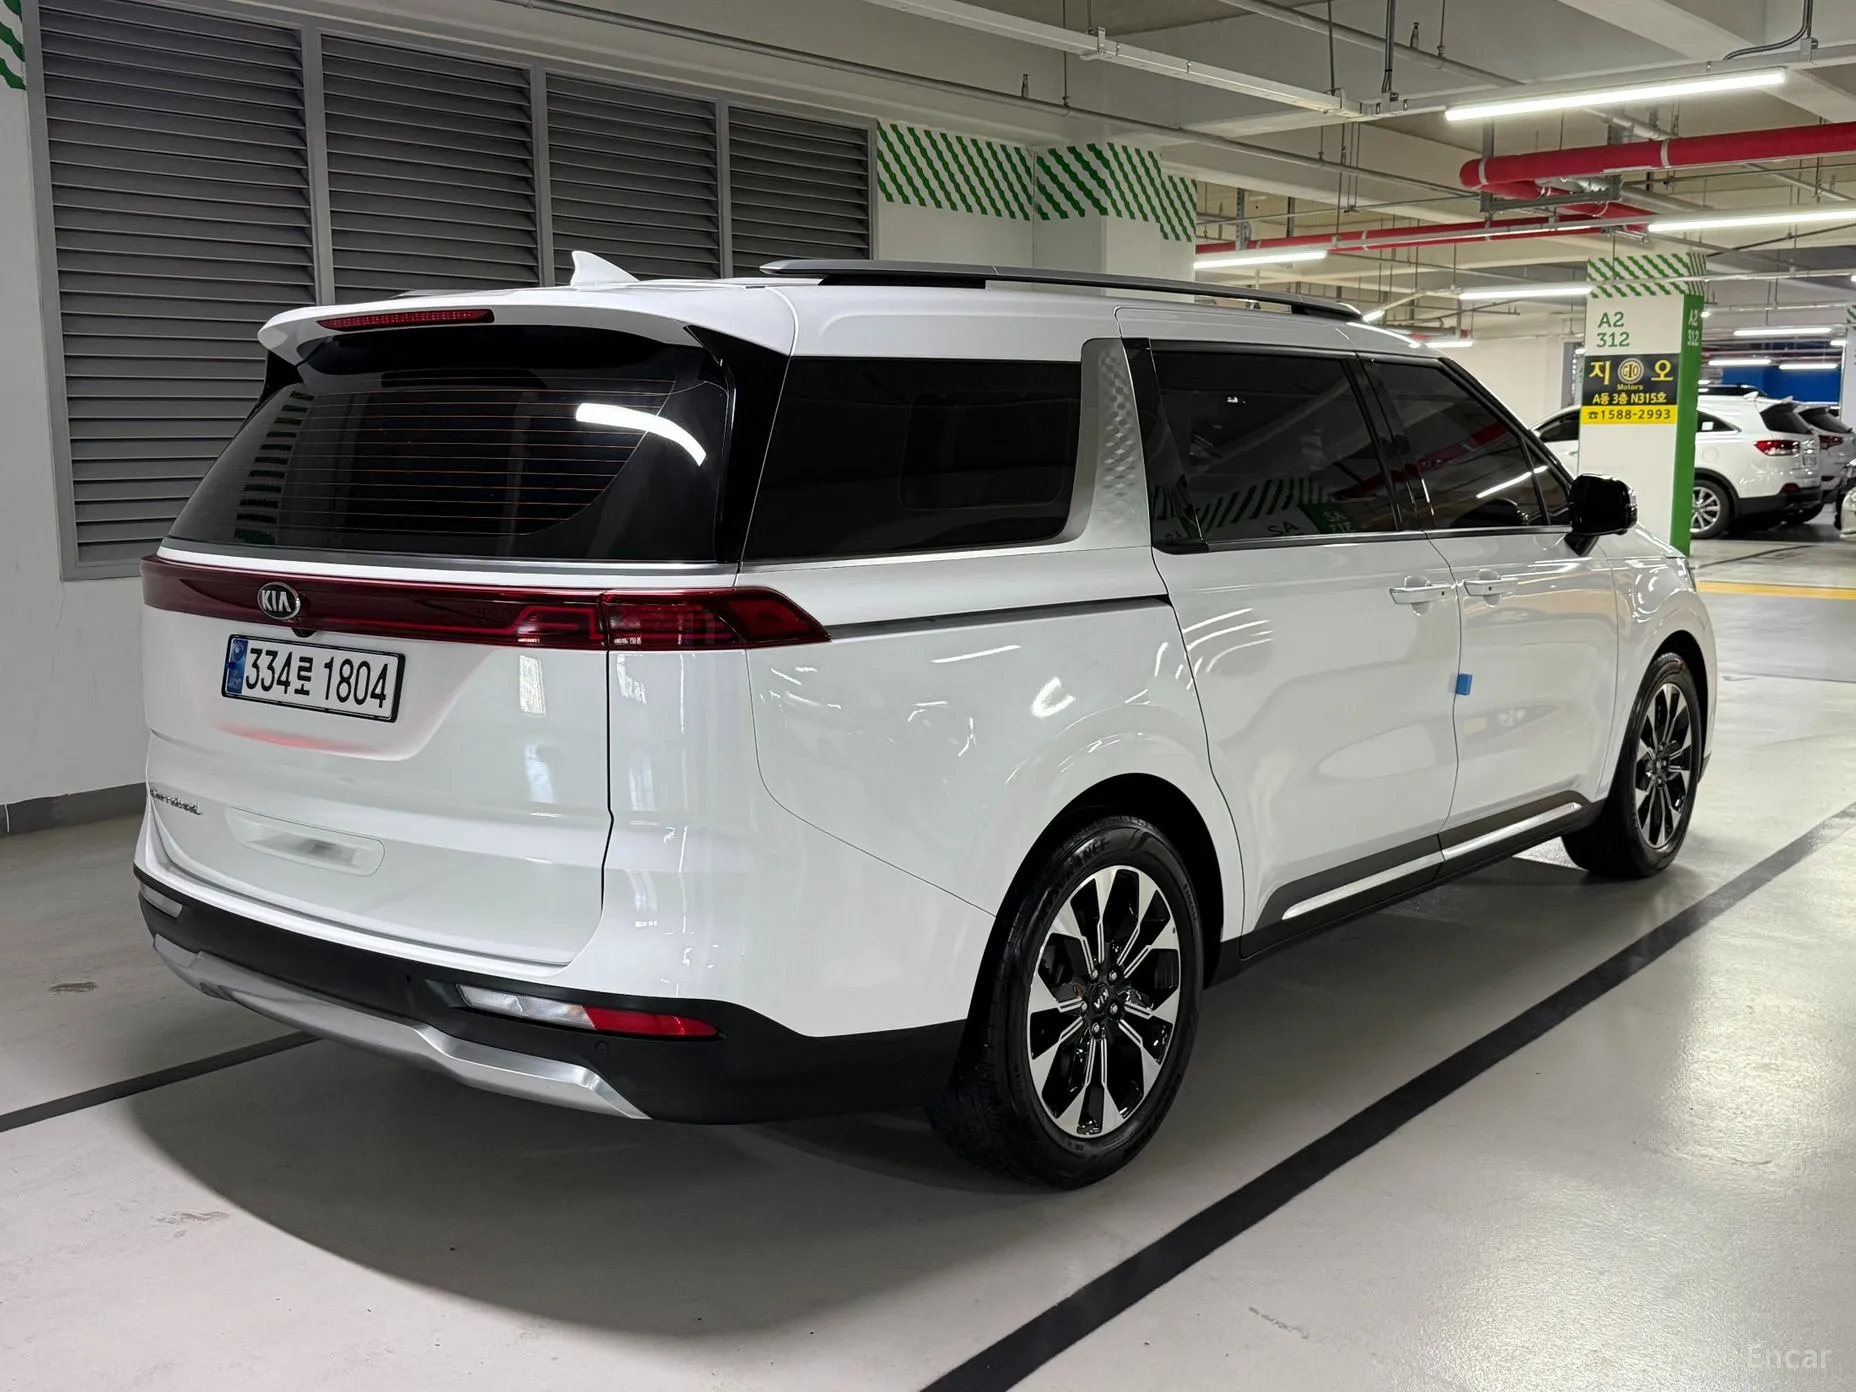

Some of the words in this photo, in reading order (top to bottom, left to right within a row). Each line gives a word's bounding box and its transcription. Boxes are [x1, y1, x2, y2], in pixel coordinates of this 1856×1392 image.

[1597, 311, 1625, 328] A2
[1688, 309, 1699, 326] A2
[1596, 332, 1630, 348] 312
[1687, 329, 1699, 346] 312
[1588, 360, 1611, 385] 지
[1651, 359, 1674, 381] 오
[1592, 392, 1610, 405] A동
[1612, 392, 1628, 405] 3층
[1630, 392, 1667, 404] N315호
[1601, 409, 1671, 420] 1588-2993
[262, 589, 292, 612] KIA
[246, 647, 314, 697] 334로
[324, 656, 389, 709] 1804
